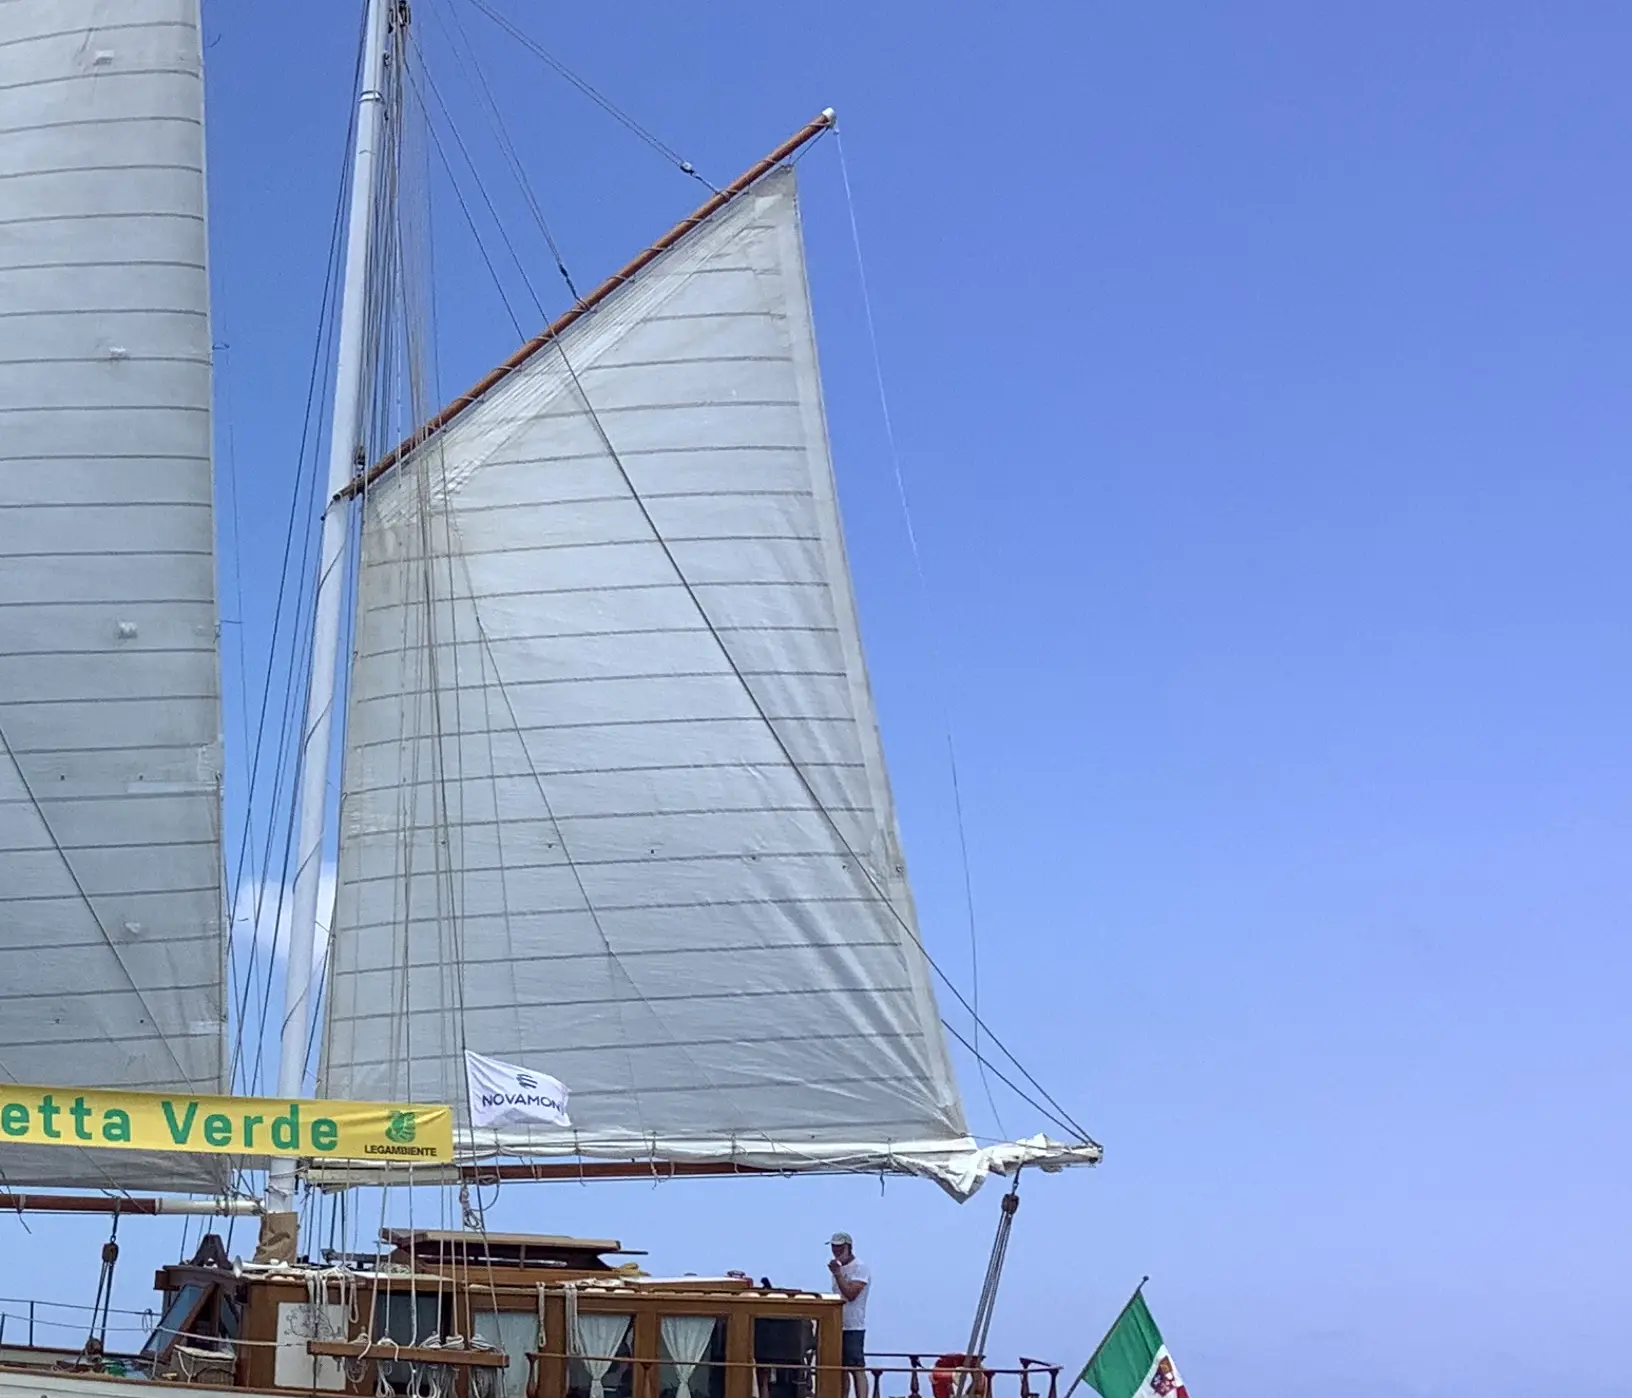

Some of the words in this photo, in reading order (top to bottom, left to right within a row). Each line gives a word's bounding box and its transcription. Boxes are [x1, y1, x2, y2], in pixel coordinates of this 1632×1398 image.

[482, 1093, 565, 1115] NOVAMON
[161, 1100, 339, 1152] Verde
[364, 1144, 438, 1157] LEGAMBIENTE
